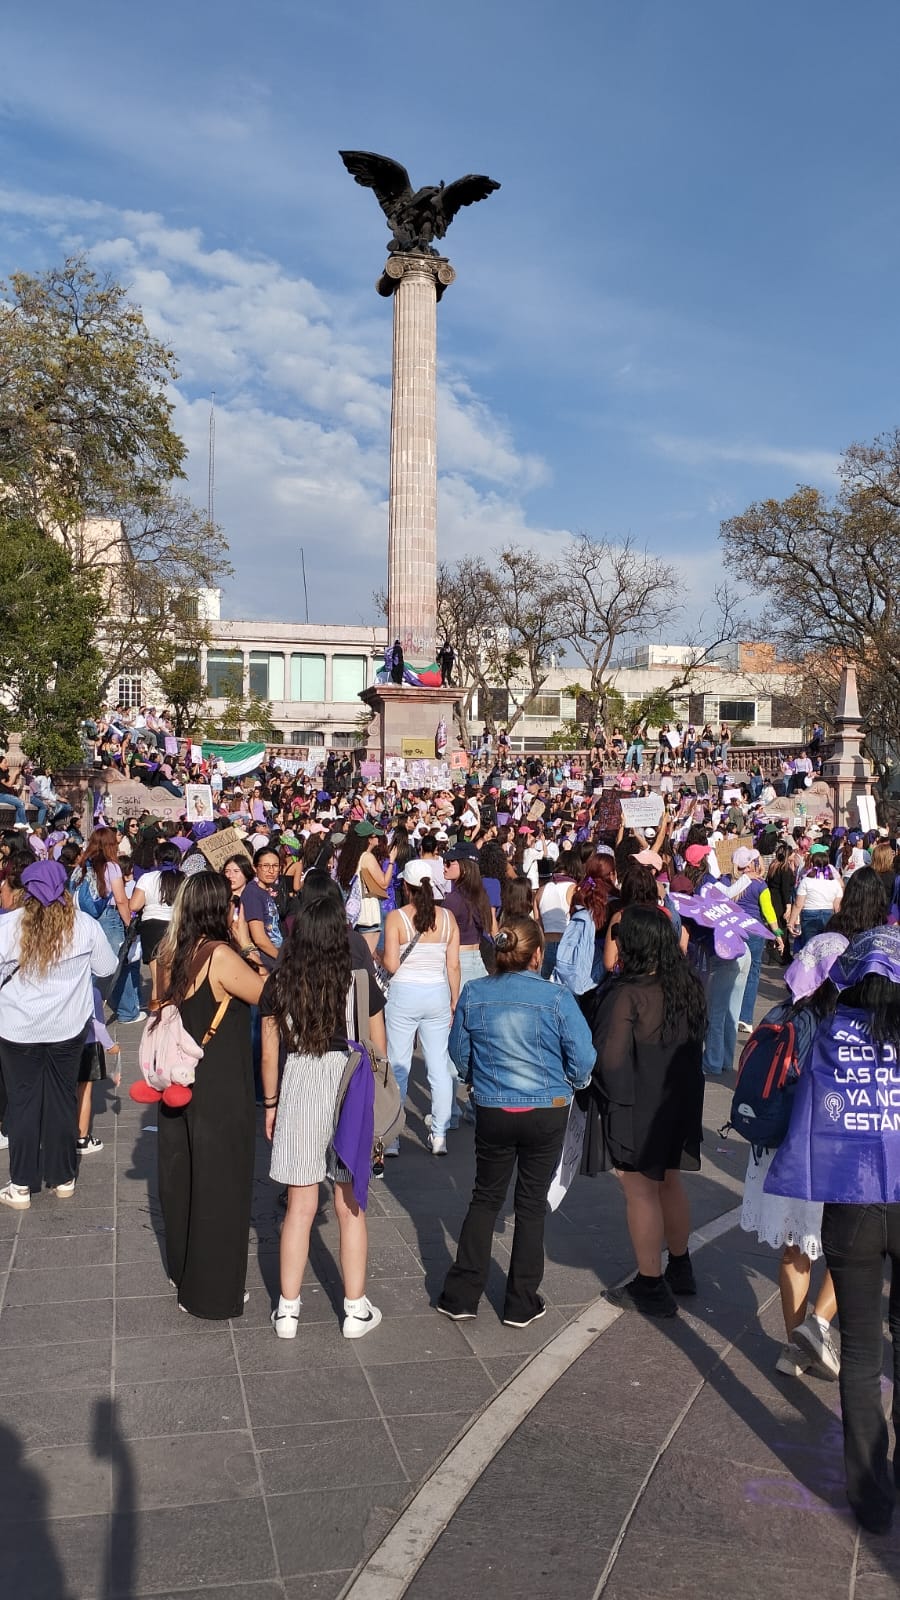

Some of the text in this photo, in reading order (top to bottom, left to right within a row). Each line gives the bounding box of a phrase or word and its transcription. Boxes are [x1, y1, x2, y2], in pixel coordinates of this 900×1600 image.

[838, 1045, 875, 1061] ECO
[834, 1067, 900, 1086] LAS QU
[846, 1089, 872, 1106] YA
